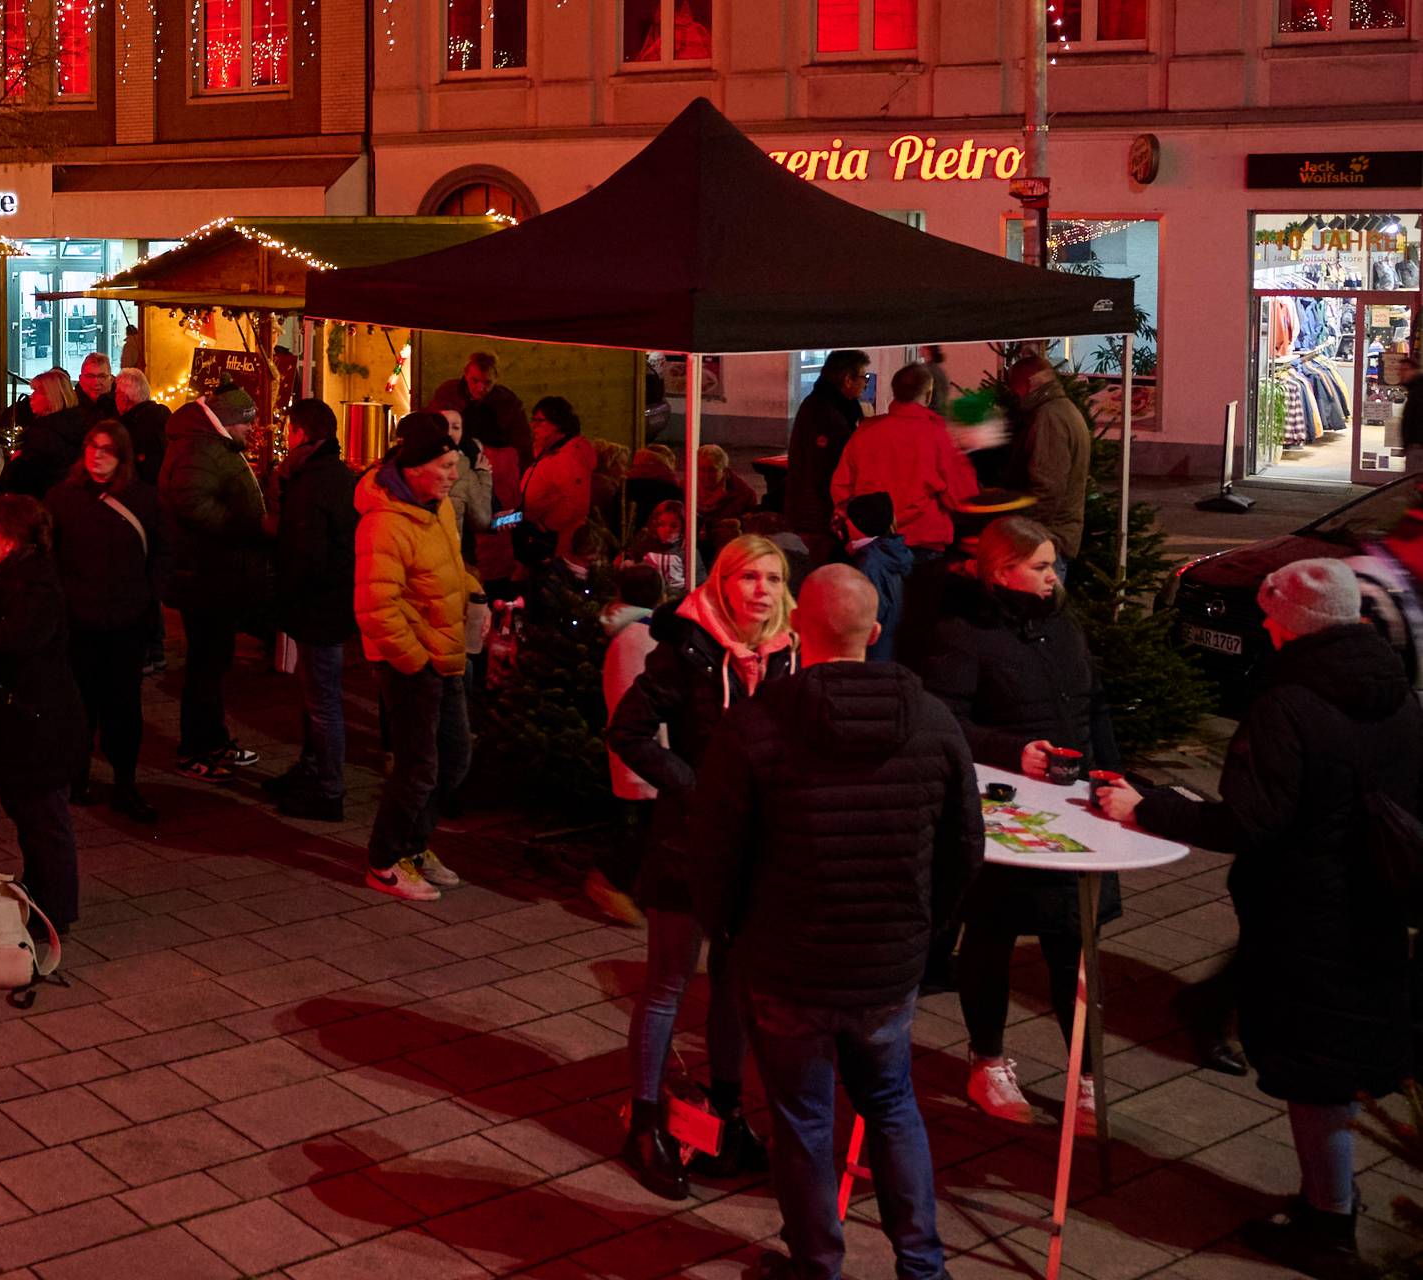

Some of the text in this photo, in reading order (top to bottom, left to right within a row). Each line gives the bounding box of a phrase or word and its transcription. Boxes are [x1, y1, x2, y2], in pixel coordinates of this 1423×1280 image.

[888, 134, 1026, 181] Pietro
[1299, 161, 1335, 173] Jack
[1299, 172, 1364, 183] Wolfskin
[1312, 229, 1397, 252] JAHRE
[1214, 634, 1240, 651] 1707
